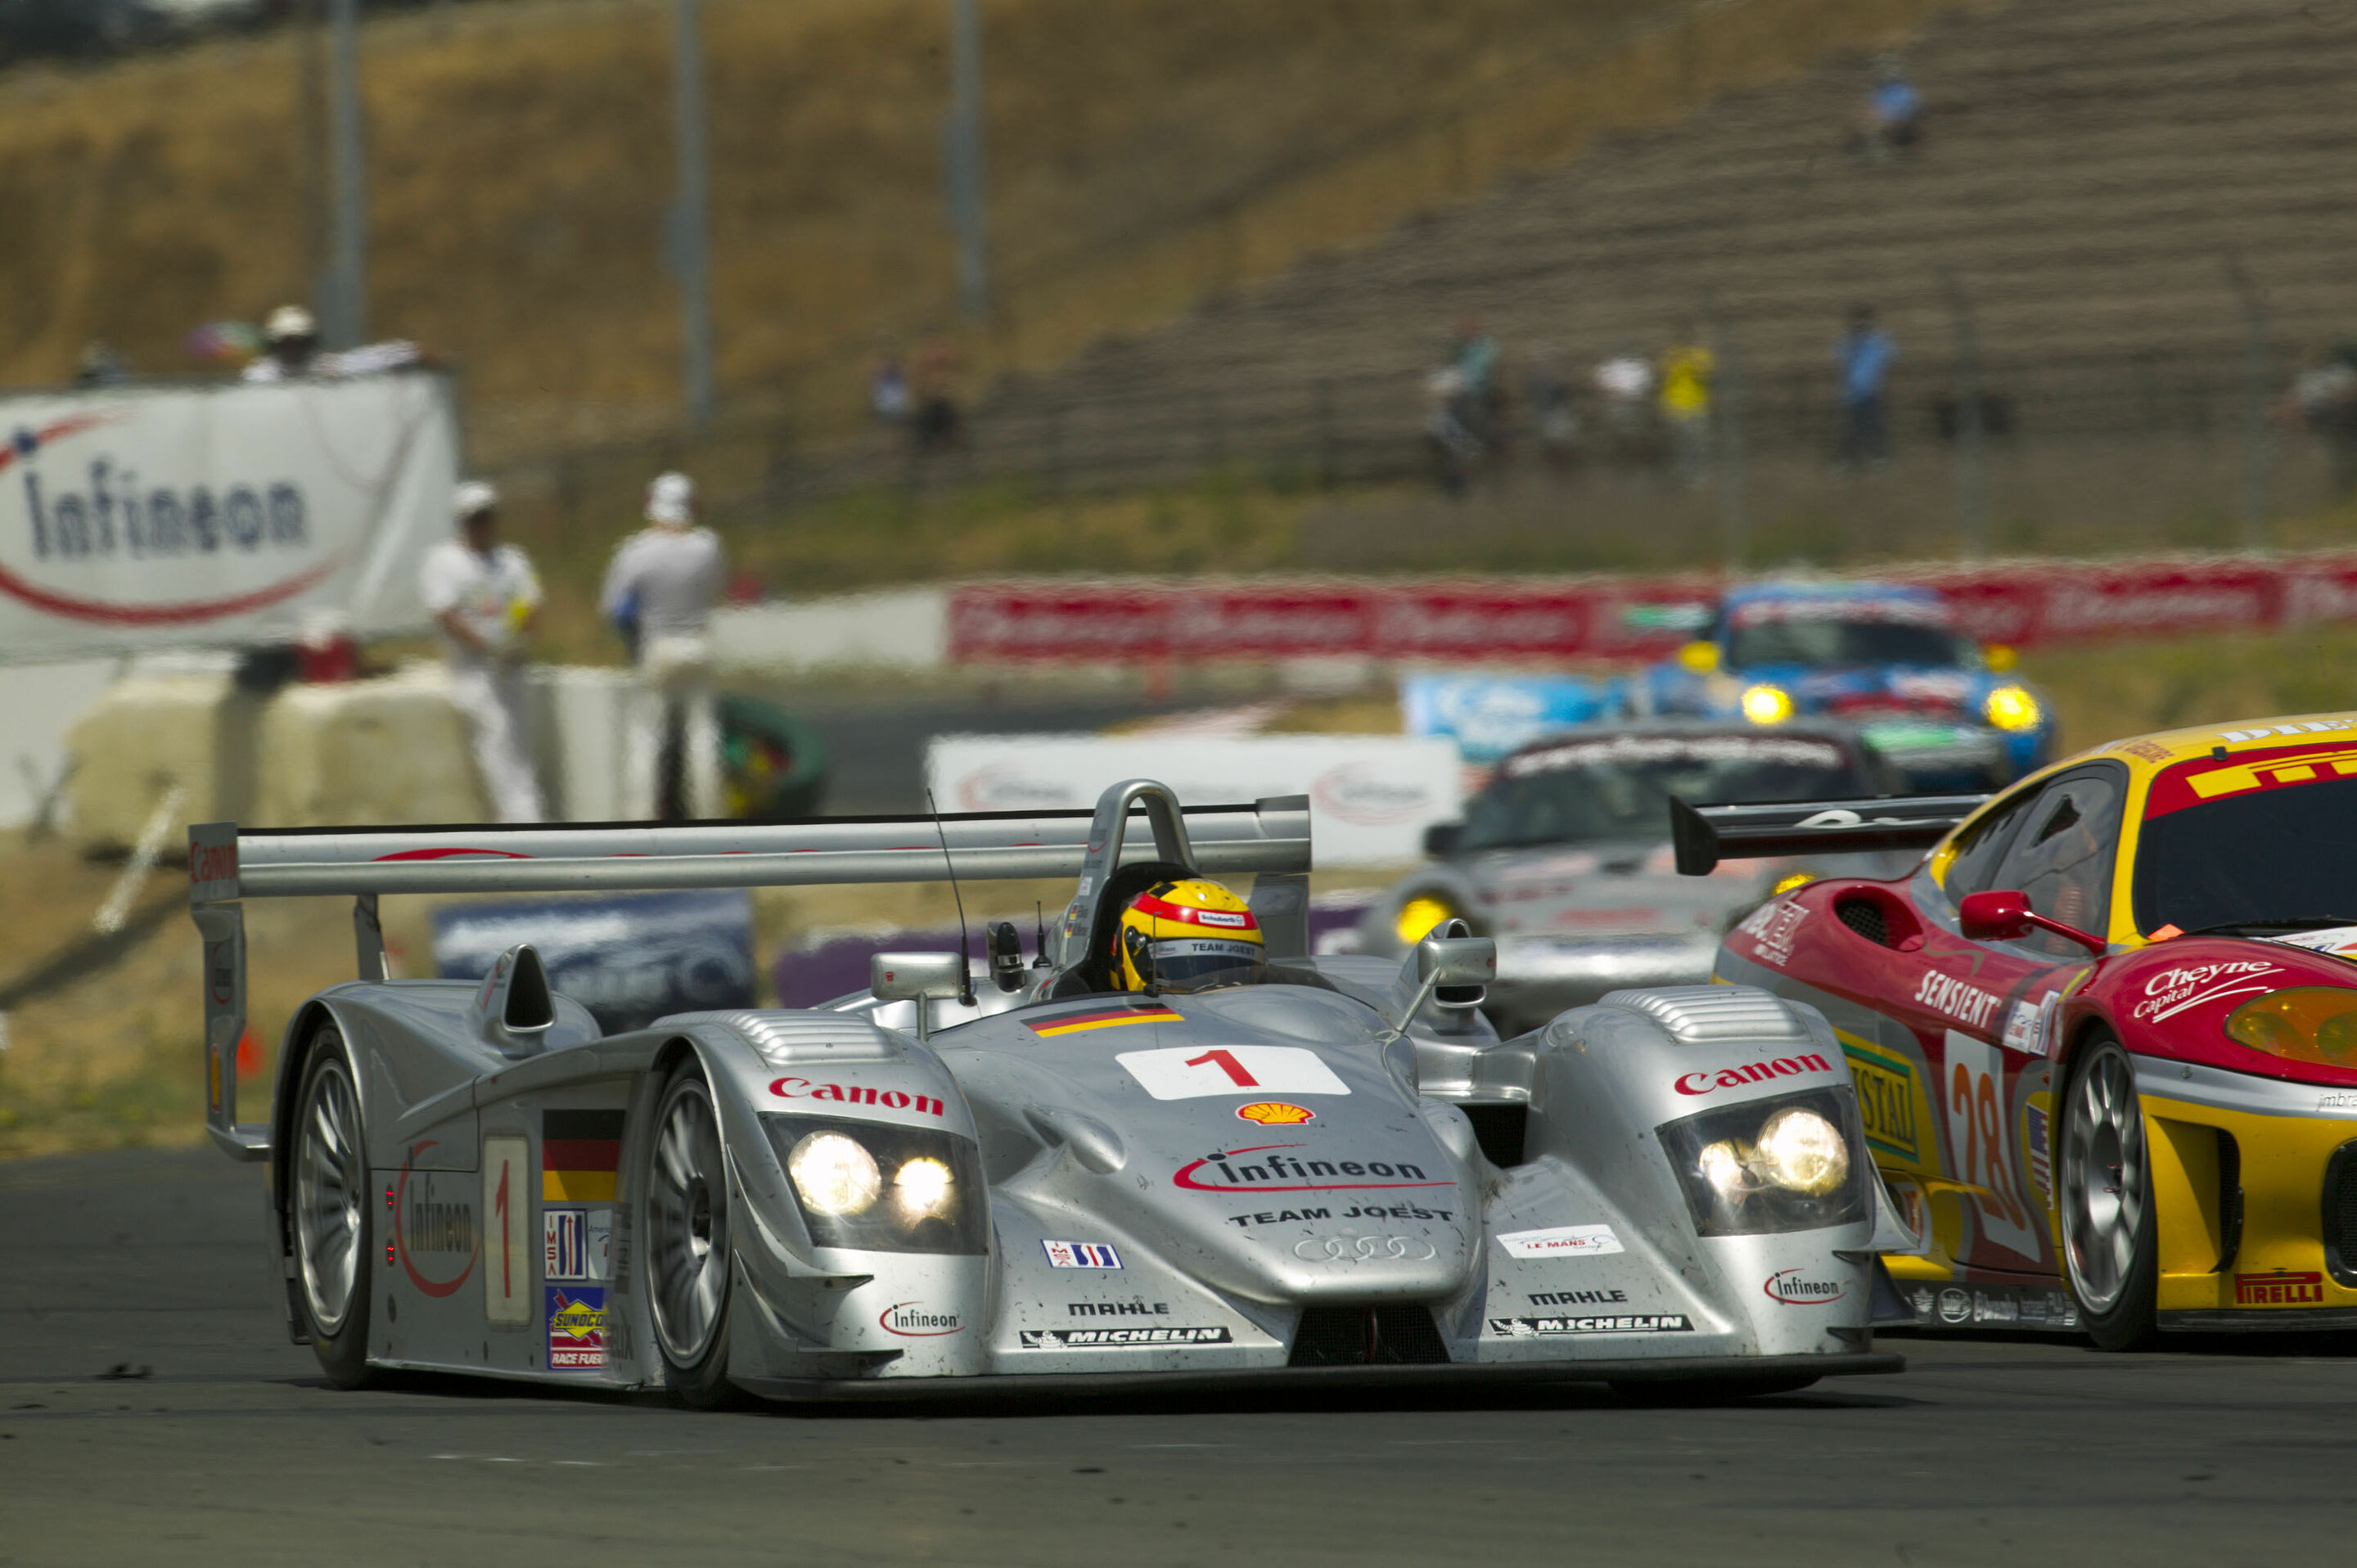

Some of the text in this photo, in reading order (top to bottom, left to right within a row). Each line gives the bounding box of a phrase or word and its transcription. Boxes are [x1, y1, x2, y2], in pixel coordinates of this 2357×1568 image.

[1192, 942, 1255, 956] TEAM JOEST
[2145, 961, 2272, 997] Cheyne
[1914, 970, 1998, 1029] SENSIENT
[2134, 981, 2196, 1018] Capital
[1185, 1049, 1260, 1088] 1
[1674, 1053, 1832, 1096] Canon
[768, 1077, 944, 1117] Canon
[1954, 1062, 2026, 1232] 28
[496, 1159, 511, 1299] 1
[1229, 1206, 1455, 1228] TEAM JOEST
[547, 1215, 557, 1276] IMSA
[1548, 1240, 1586, 1248] MANS
[1528, 1290, 1629, 1306] MAHLE
[2235, 1272, 2323, 1304] PIRELLI
[1067, 1301, 1169, 1317] MAHLE
[1538, 1315, 1683, 1331] MICHELIN
[1066, 1327, 1222, 1345] MICHELIN
[552, 1353, 578, 1365] RACE
